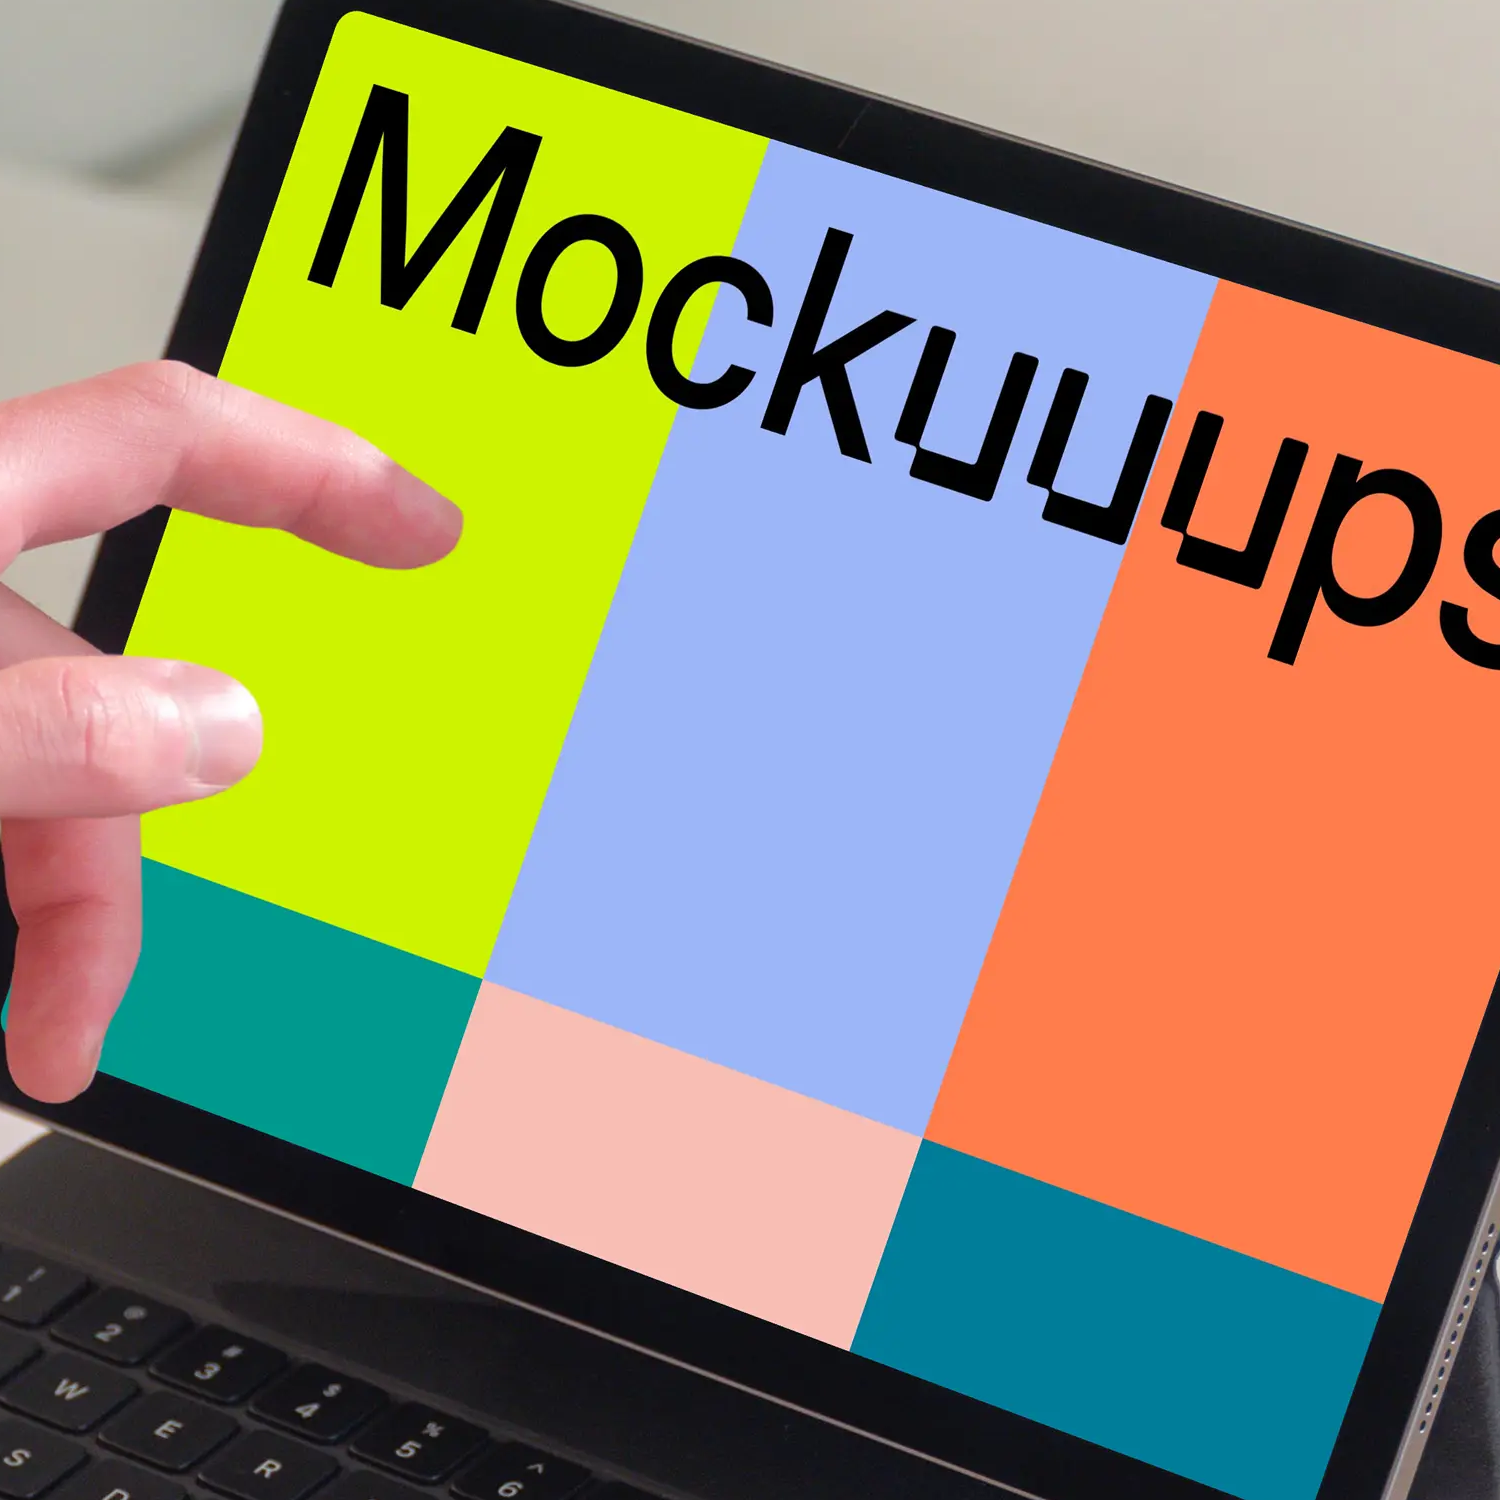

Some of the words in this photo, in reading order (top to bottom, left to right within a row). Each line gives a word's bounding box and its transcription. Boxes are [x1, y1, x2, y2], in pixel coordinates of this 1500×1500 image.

[2, 1284, 23, 1303] 1
[94, 1322, 124, 1343] 2
[192, 1361, 222, 1381] 3
[294, 1402, 321, 1419] 4
[394, 1439, 423, 1459] 5
[496, 1480, 525, 1499] 6
[53, 1377, 90, 1401] W
[153, 1418, 184, 1440] E
[252, 1458, 283, 1480] R
[2, 1447, 32, 1468] S
